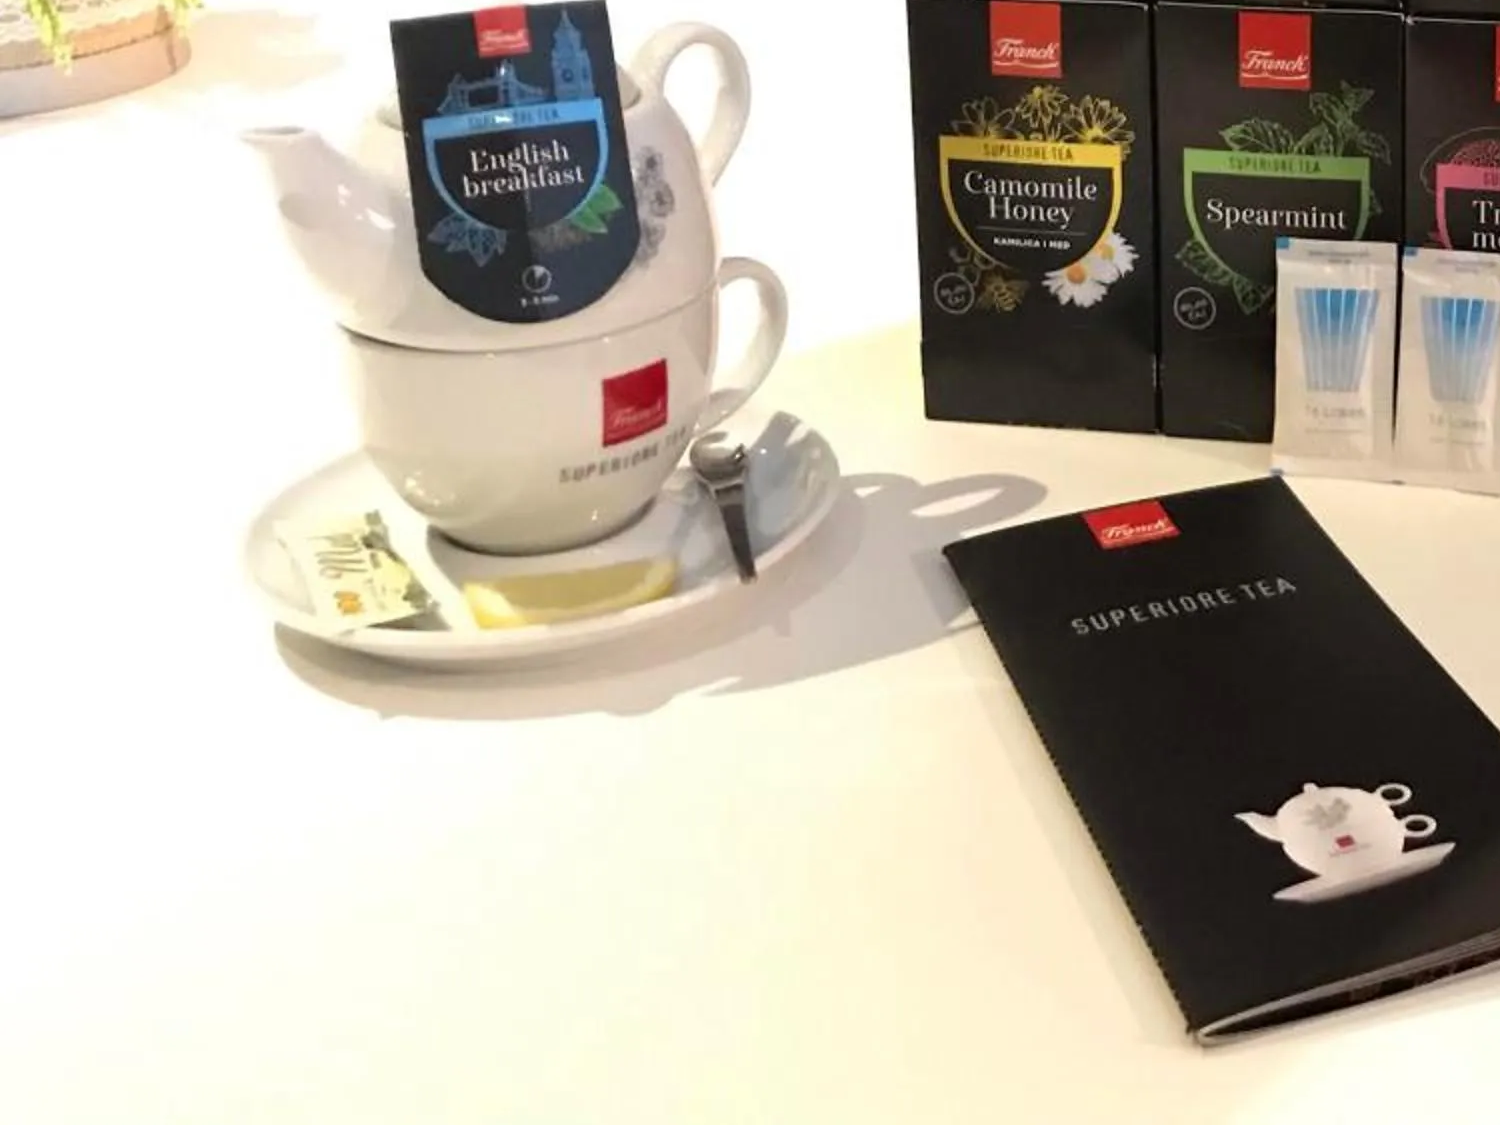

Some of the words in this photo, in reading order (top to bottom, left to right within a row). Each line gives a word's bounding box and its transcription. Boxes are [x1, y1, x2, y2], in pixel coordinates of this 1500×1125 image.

[993, 38, 1059, 60] Franck
[1241, 49, 1309, 73] Franck
[471, 139, 570, 173] English
[1050, 146, 1074, 162] TEA
[1298, 158, 1322, 174] TEA
[463, 164, 585, 198] breakfast
[963, 170, 1098, 201] Camomile
[989, 196, 1075, 230] Honey
[1206, 197, 1348, 230] Spearmint
[1101, 516, 1171, 541] Franck
[1070, 586, 1237, 635] SUPERIORE
[1240, 575, 1297, 602] TEA
